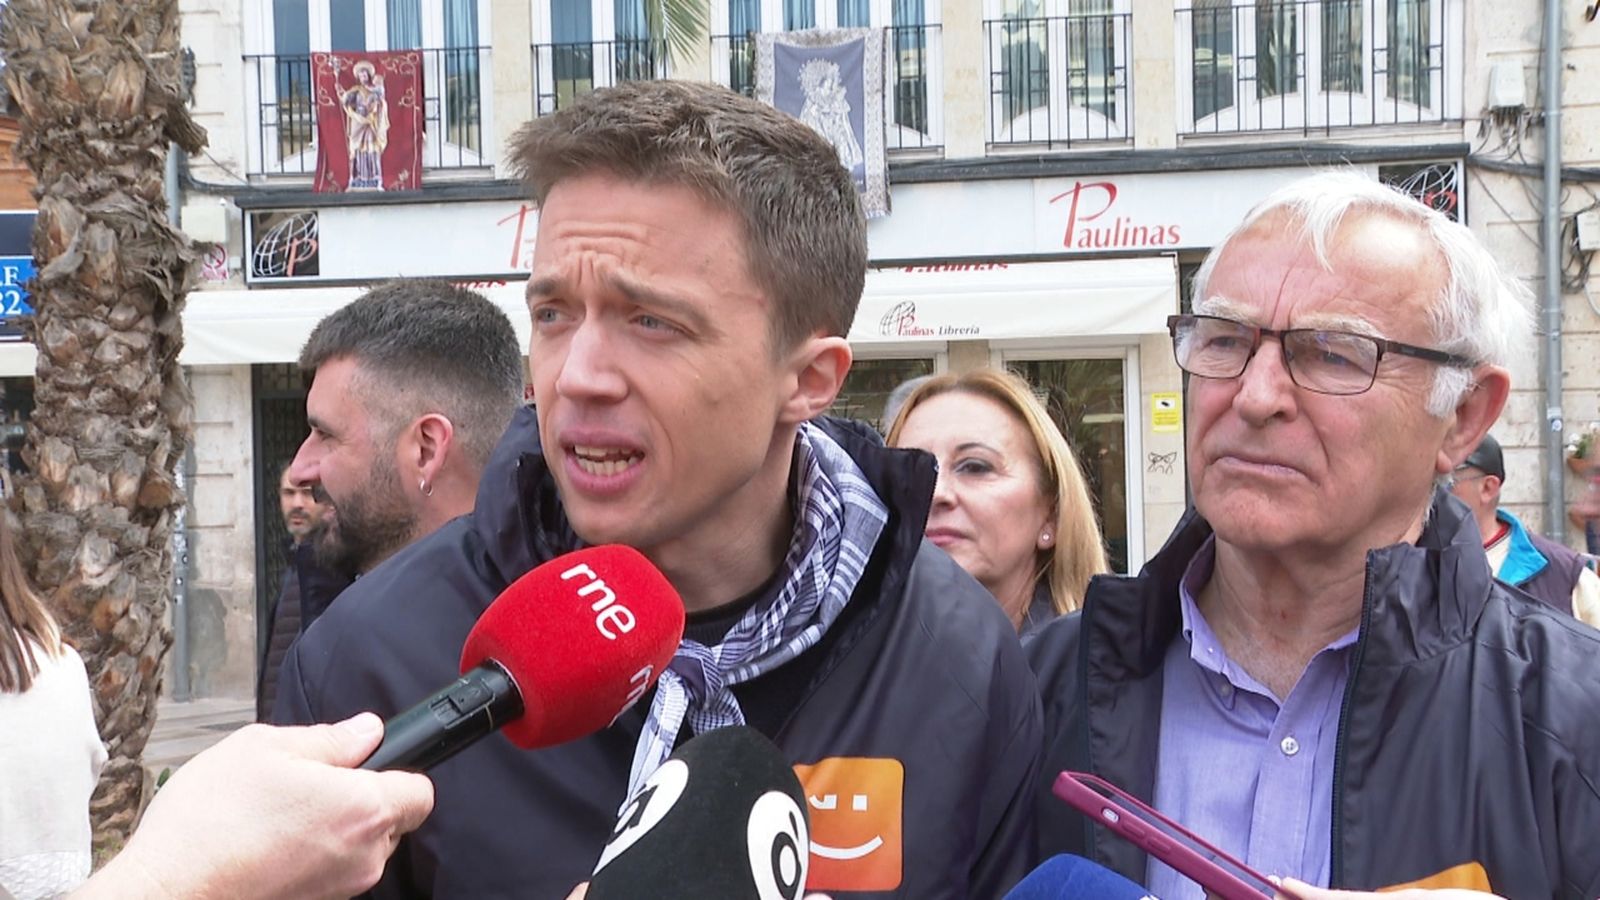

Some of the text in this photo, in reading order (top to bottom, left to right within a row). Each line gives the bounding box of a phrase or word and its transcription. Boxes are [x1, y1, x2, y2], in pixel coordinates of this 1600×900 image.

[1050, 182, 1181, 248] Paulinas
[0, 266, 19, 286] F
[0, 290, 22, 315] 2
[896, 314, 935, 336] Paulinas
[561, 563, 636, 640] rne
